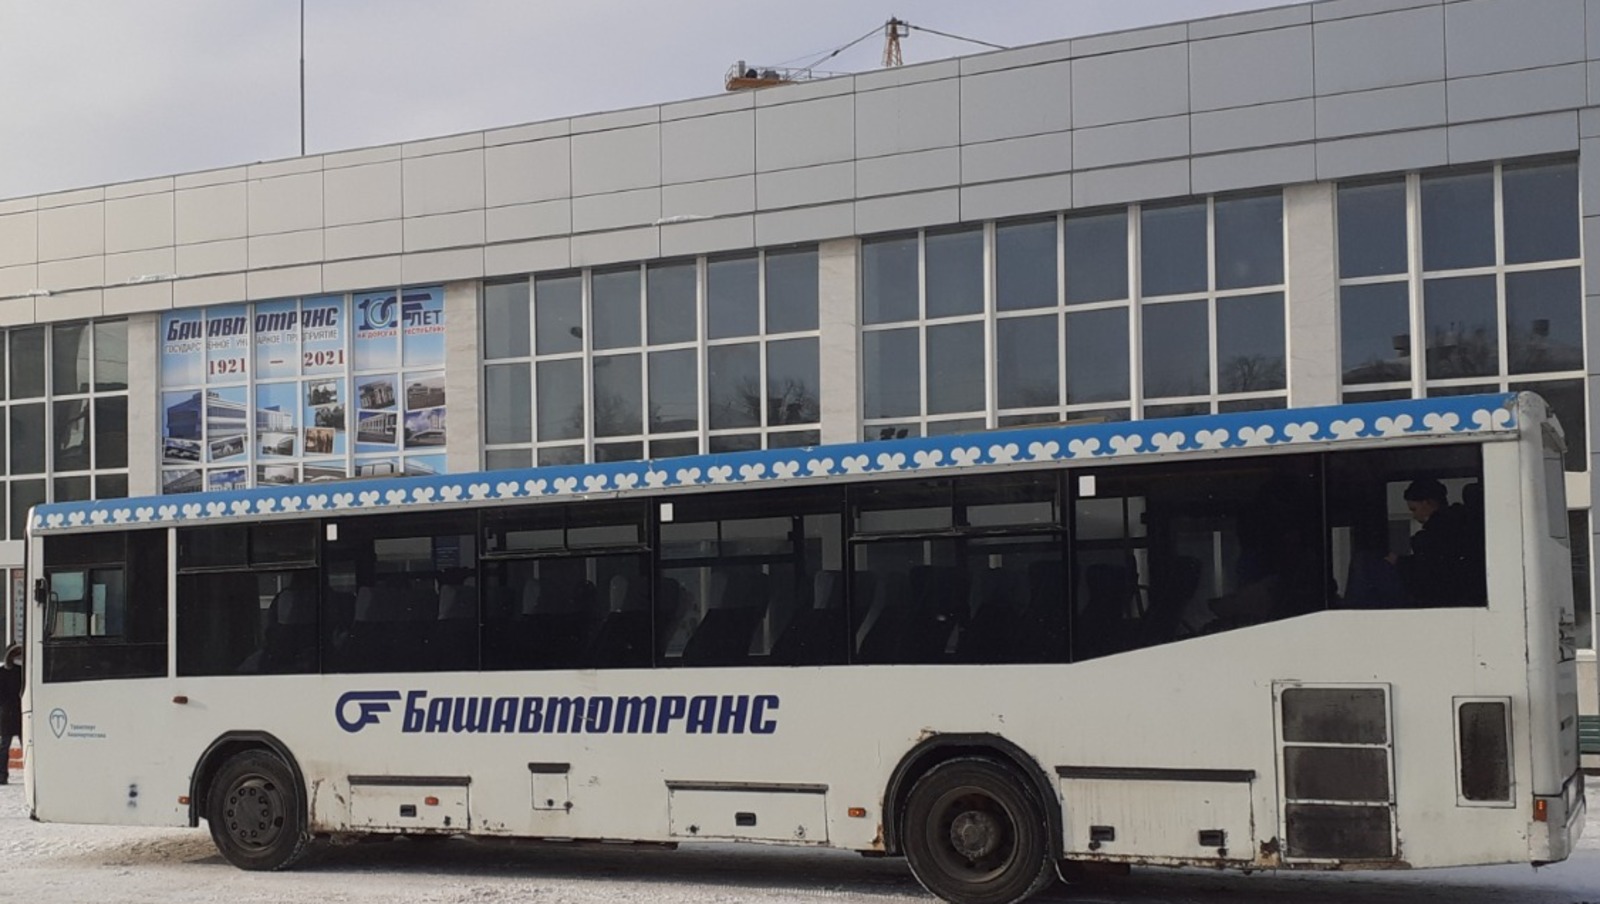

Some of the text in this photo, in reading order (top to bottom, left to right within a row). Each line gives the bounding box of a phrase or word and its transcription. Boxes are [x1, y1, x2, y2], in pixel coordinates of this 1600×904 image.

[410, 309, 442, 326] ЛЕТ
[209, 358, 246, 375] 1921
[303, 350, 344, 367] 2021
